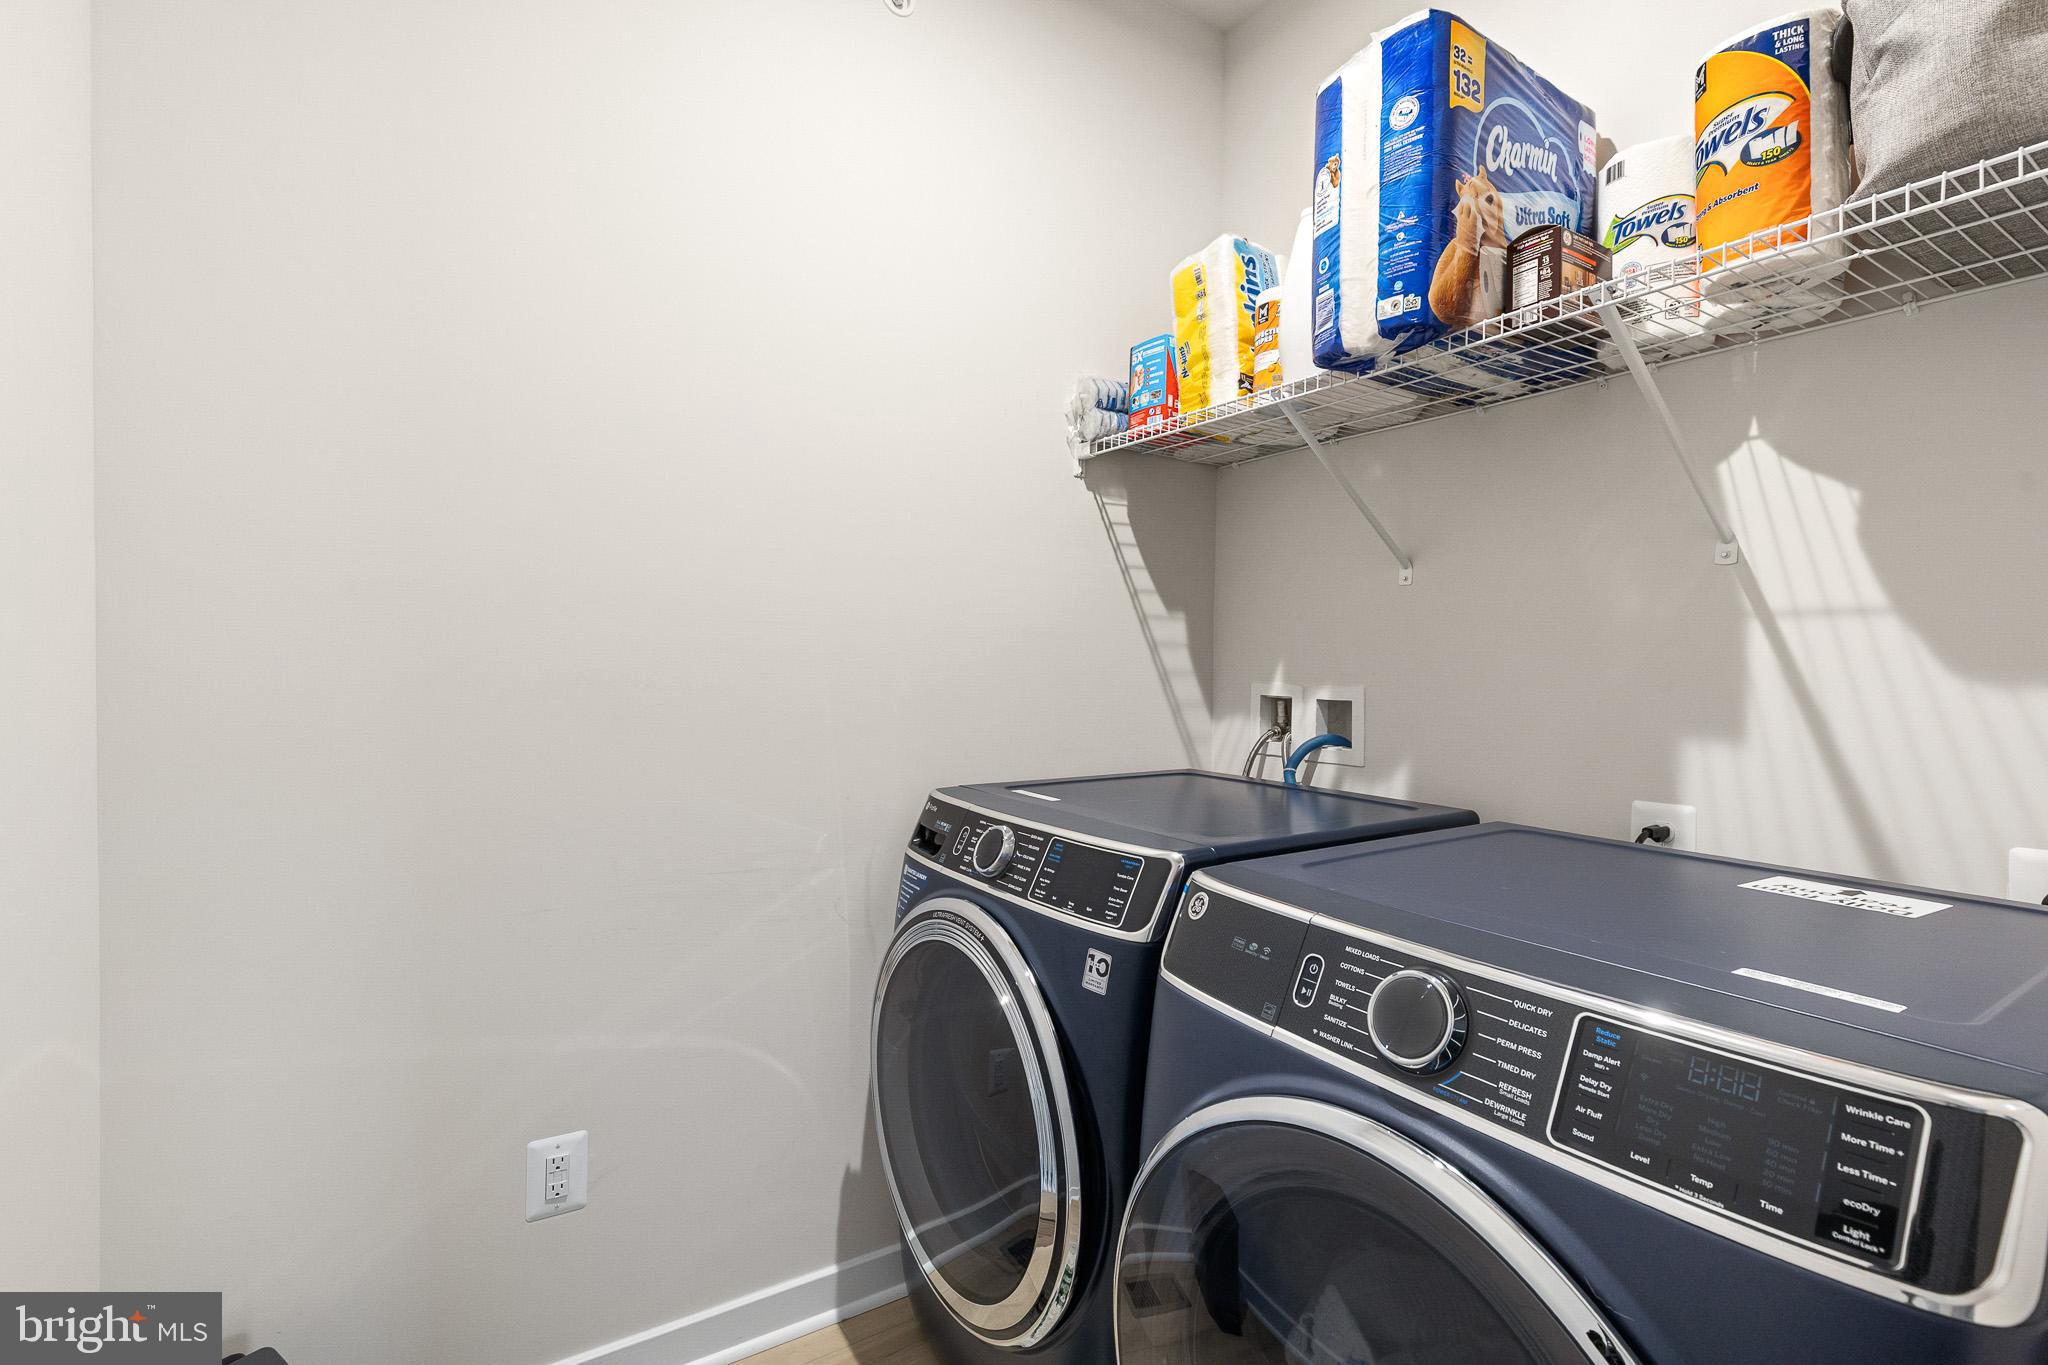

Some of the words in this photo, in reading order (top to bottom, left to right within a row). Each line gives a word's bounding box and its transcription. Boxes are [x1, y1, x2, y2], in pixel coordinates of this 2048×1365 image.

[1772, 24, 1804, 40] THICK
[1774, 40, 1781, 48] &
[1783, 34, 1804, 46] LONG
[1453, 45, 1466, 63] 32
[1774, 42, 1804, 55] LASTING
[1453, 69, 1481, 104] 132
[1695, 105, 1768, 170] owels
[1486, 125, 1558, 183] Charmin
[1761, 146, 1781, 160] 150
[1707, 203, 1712, 212] &
[1712, 182, 1759, 208] Absorbent
[1515, 205, 1546, 226] Ultra
[1547, 207, 1570, 229] Soft
[1612, 202, 1687, 247] Towels
[1828, 899, 1914, 916] Dolly
[1345, 945, 1362, 956] MIXED
[1362, 951, 1380, 962] LOADS
[1088, 953, 1110, 978] 10
[1340, 962, 1365, 975] COTTONS
[1335, 979, 1356, 992] TOWELS
[1329, 993, 1347, 1005] BULKY
[1513, 1000, 1537, 1013] QUICK
[1537, 1007, 1553, 1018] DRY
[1324, 1014, 1347, 1028] SANITIZE
[1508, 1019, 1548, 1038] DELICATES
[1319, 1030, 1341, 1045] WASHER
[1341, 1040, 1354, 1050] LINK
[1595, 1026, 1621, 1040] Reduce
[1595, 1036, 1617, 1048] Static
[1496, 1038, 1517, 1050] PERM
[1518, 1044, 1542, 1060] PRESS
[1583, 1049, 1603, 1061] Damp
[1603, 1056, 1621, 1067] Alert
[1497, 1060, 1520, 1074] TIMED
[1520, 1069, 1537, 1081] DRY
[1498, 1081, 1532, 1101] REFRESH
[1579, 1083, 1597, 1094] Remote
[1597, 1090, 1610, 1099] Start
[1580, 1075, 1599, 1087] Delay
[1599, 1081, 1612, 1092] Dry
[1499, 1089, 1514, 1100] Small
[1514, 1094, 1530, 1106] Loads
[1484, 1098, 1527, 1122] DEWRINKLE
[1494, 1109, 1509, 1121] Large
[1509, 1115, 1525, 1127] Loads
[1575, 1105, 1586, 1114] Air
[1586, 1109, 1603, 1120] Fluff
[1846, 1104, 1884, 1122] Wrinkle
[1885, 1115, 1911, 1129] Care
[1572, 1127, 1595, 1142] Sound
[1841, 1132, 1868, 1147] More
[1868, 1140, 1895, 1156] Time
[1630, 1151, 1650, 1165] Level
[1690, 1173, 1714, 1189] Temp
[1837, 1162, 1860, 1177] Less
[1861, 1169, 1888, 1186] Time
[1679, 1186, 1693, 1196] Hold
[1699, 1194, 1725, 1208] Seconds
[1760, 1199, 1784, 1216] Time
[1842, 1198, 1881, 1217] ecoDry
[1831, 1230, 1860, 1247] Control
[1860, 1239, 1879, 1253] Lock
[1842, 1224, 1871, 1242] Light
